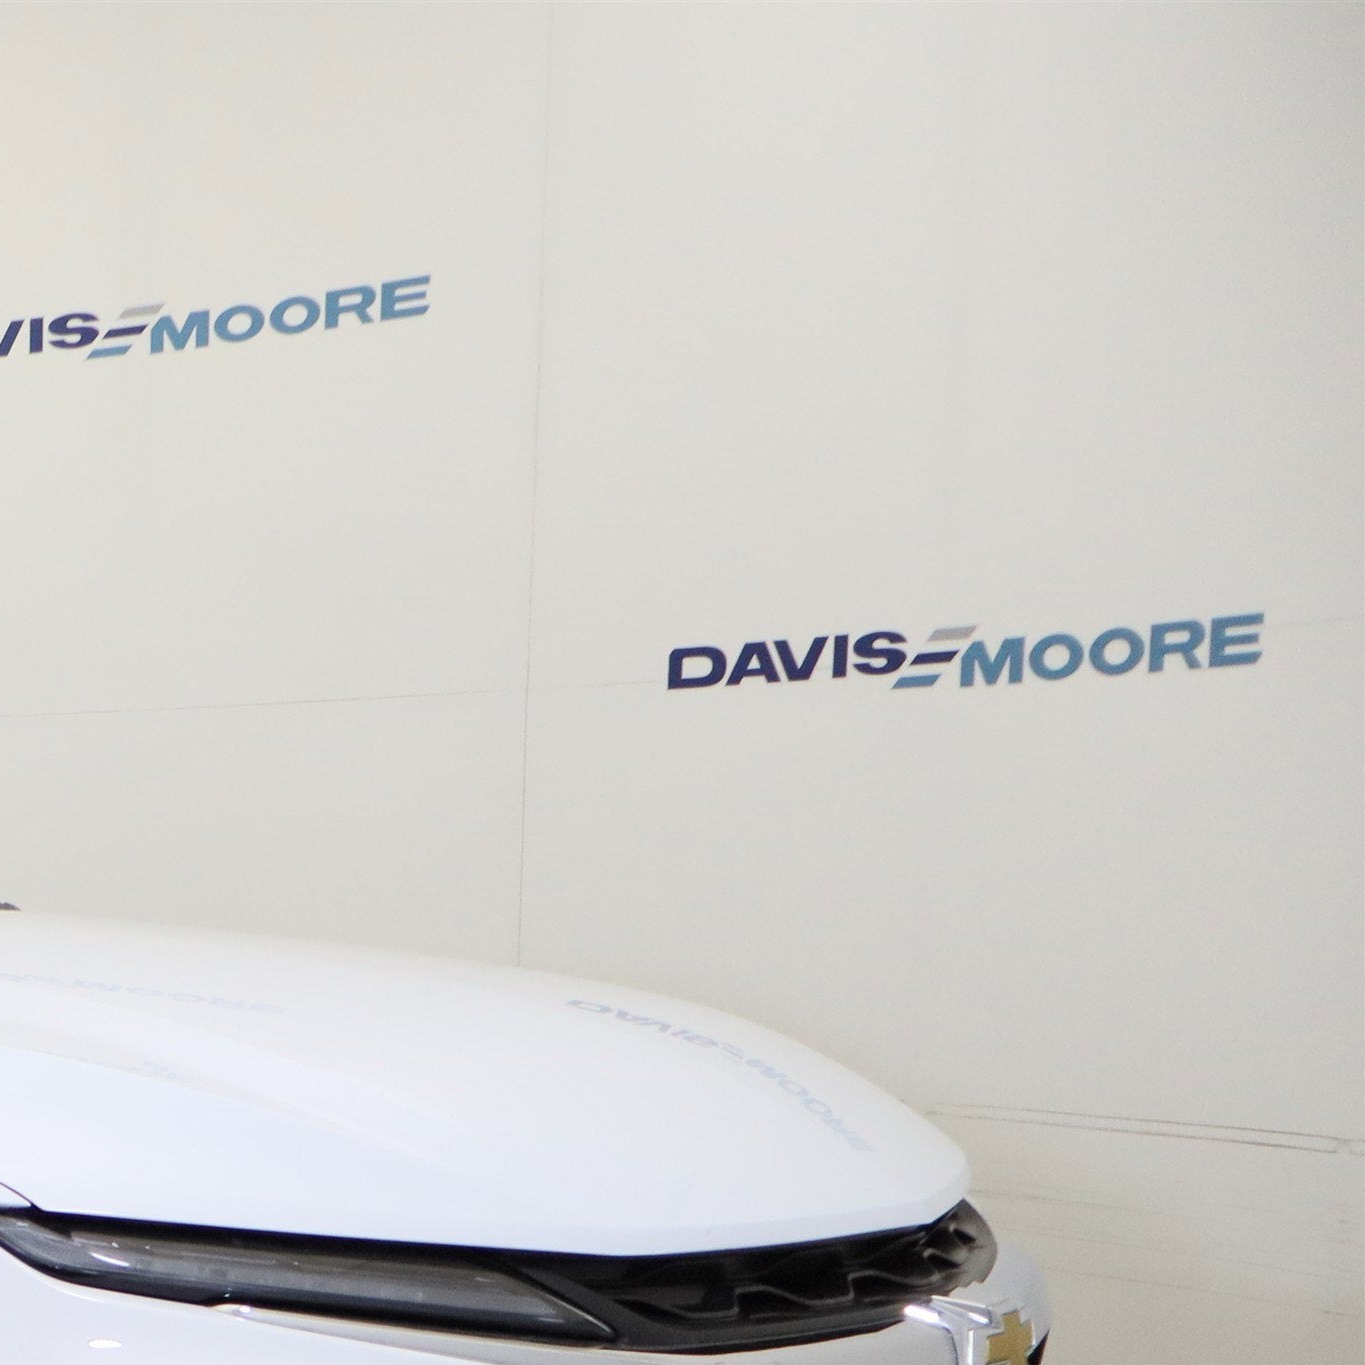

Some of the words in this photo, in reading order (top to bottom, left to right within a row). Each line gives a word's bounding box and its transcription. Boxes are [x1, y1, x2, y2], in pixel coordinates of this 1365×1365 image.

[150, 274, 431, 355] MOORE
[666, 631, 909, 691] DAVIS
[960, 613, 1265, 688] MOORE
